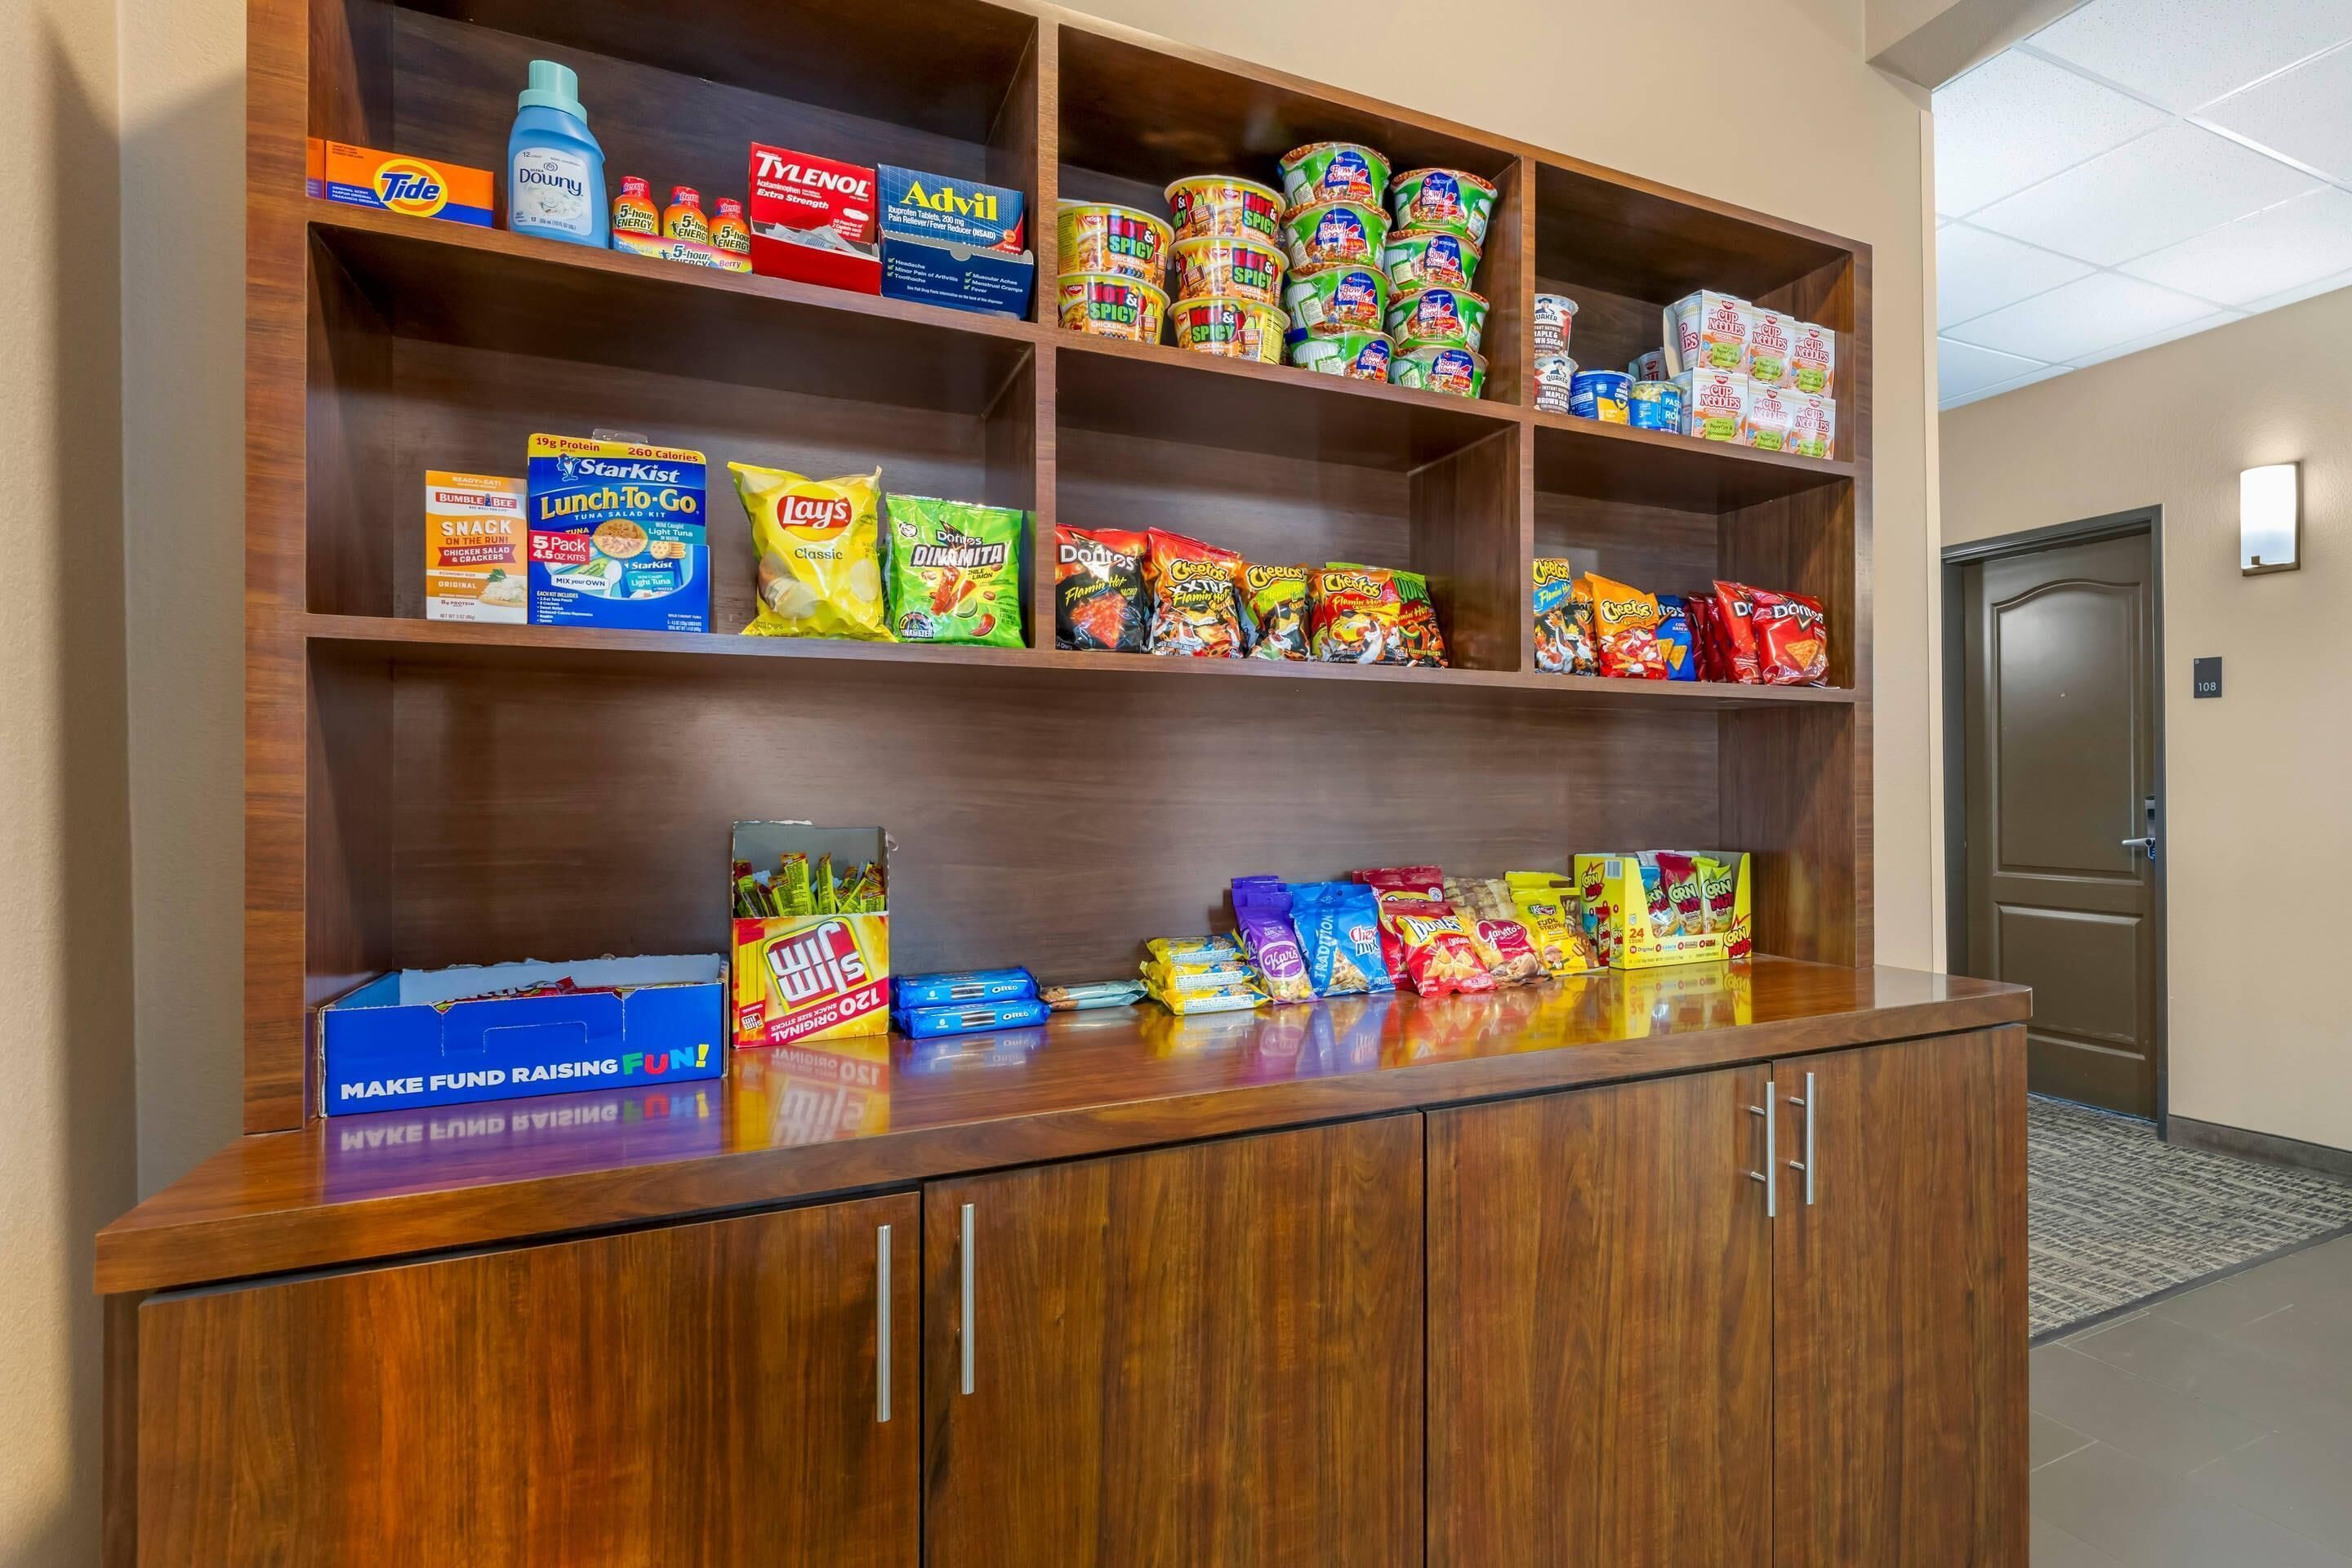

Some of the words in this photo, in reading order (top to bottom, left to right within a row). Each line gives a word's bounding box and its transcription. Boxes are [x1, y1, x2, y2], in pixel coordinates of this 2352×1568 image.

[755, 152, 869, 198] TYLENOL
[1331, 164, 1354, 177] Bowl
[380, 172, 441, 203] Tide
[519, 168, 582, 197] Downy
[757, 179, 800, 194] Acetaminophen
[757, 189, 784, 200] Extra
[786, 194, 830, 210] Strength
[900, 180, 998, 221] Advil
[1245, 194, 1272, 217] HOT
[1270, 209, 1276, 221] &
[620, 205, 653, 221] 5-hour
[889, 205, 917, 217] Ibuprofen
[918, 210, 942, 222] Tablets,
[942, 215, 954, 224] 200
[955, 219, 964, 227] mg
[617, 217, 653, 229] ENERGY
[682, 215, 709, 233] 5-hou
[889, 214, 902, 222] Pain
[947, 224, 972, 235] Reducer
[973, 228, 996, 241] (NSAID)
[1109, 216, 1147, 242] HOT
[1144, 230, 1154, 244] &
[1243, 211, 1275, 236] SPICY
[1322, 221, 1347, 233] Bowl
[673, 245, 710, 261] 5-hour
[1108, 235, 1154, 260] SPICY
[719, 261, 742, 269] Berry
[895, 260, 926, 270] Headache
[1234, 250, 1267, 272] HOT
[1264, 262, 1273, 274] &
[894, 266, 912, 274] Minor
[934, 274, 959, 282] Arthritis
[894, 274, 926, 283] Toothache
[973, 274, 1000, 282] Muscular
[1234, 267, 1272, 289] SPICY
[972, 280, 1000, 289] Menstrual
[1001, 285, 1023, 293] Cramps
[1089, 284, 1128, 305] HOT
[1126, 294, 1138, 307] &
[1089, 302, 1138, 324] SPICY
[1191, 307, 1224, 326] HOT
[1222, 312, 1235, 323] &
[1717, 310, 1739, 323] CUP
[1090, 321, 1122, 329] CHICKEN
[1192, 325, 1236, 342] SPICY
[1708, 318, 1745, 336] NOODLES
[1761, 324, 1781, 337] CUP
[1752, 332, 1788, 351] NOODLES
[1803, 337, 1823, 350] CUP
[1795, 345, 1829, 363] NOODLES
[1699, 392, 1741, 409] NOODLES
[1709, 385, 1733, 400] CUP
[1804, 408, 1824, 420] CUP
[1796, 416, 1830, 433] NOODLES
[537, 438, 557, 449] 19g
[560, 440, 600, 452] Protein
[628, 448, 653, 457] 260
[655, 450, 698, 462] Calories
[578, 459, 680, 483] StarKist
[439, 493, 484, 505] BUMBLE
[493, 497, 513, 507] BEE
[541, 486, 697, 521] Lunch-To-Go
[575, 513, 604, 521] TUNA
[782, 496, 848, 530] Lay's
[441, 519, 513, 537] SNACK
[648, 528, 671, 537] Light
[446, 537, 462, 546] ON
[463, 536, 483, 546] THE
[484, 536, 509, 545] RUN!
[532, 535, 549, 549] 5
[551, 538, 586, 552] Pack
[937, 530, 983, 546] Doritos
[459, 554, 504, 563] CRACKERS
[483, 546, 510, 555] SALAD
[532, 550, 553, 559] 4.5
[555, 552, 567, 561] OZ
[567, 554, 586, 562] KITS
[795, 548, 844, 560] Classic
[911, 543, 1004, 568] DINAMITA
[1060, 545, 1134, 571] Doritos
[631, 561, 673, 569] StarKist
[1169, 559, 1228, 582] Cheetos
[439, 581, 477, 589] ORIGINAL
[652, 577, 671, 586] Tuna
[1109, 575, 1127, 588] Hot
[1247, 565, 1304, 590] Cheetos
[1322, 573, 1382, 599] Cheetos
[1601, 599, 1653, 623] Cheetos
[1773, 602, 1824, 624] Doritos
[2198, 682, 2216, 692] 108
[1582, 871, 1601, 889] CORN
[1668, 884, 1699, 904] CORN
[1703, 879, 1732, 899] CORN
[1711, 893, 1734, 911] NUT
[1349, 926, 1379, 942] Chex
[1629, 928, 1645, 938] 24
[1723, 925, 1748, 947] CORN
[929, 990, 936, 998] 6
[991, 984, 1018, 994] OREO
[814, 1003, 837, 1017] SNACK
[840, 987, 881, 1016] 120
[771, 1018, 796, 1031] STICKS
[797, 1011, 813, 1023] SIZE
[1002, 1011, 1029, 1021] OREO
[770, 1011, 838, 1043] ORIGINAL
[341, 1076, 424, 1100] MAKE
[429, 1068, 506, 1092] FUND
[512, 1058, 618, 1084] RAISING
[621, 1044, 710, 1076] FUN!
